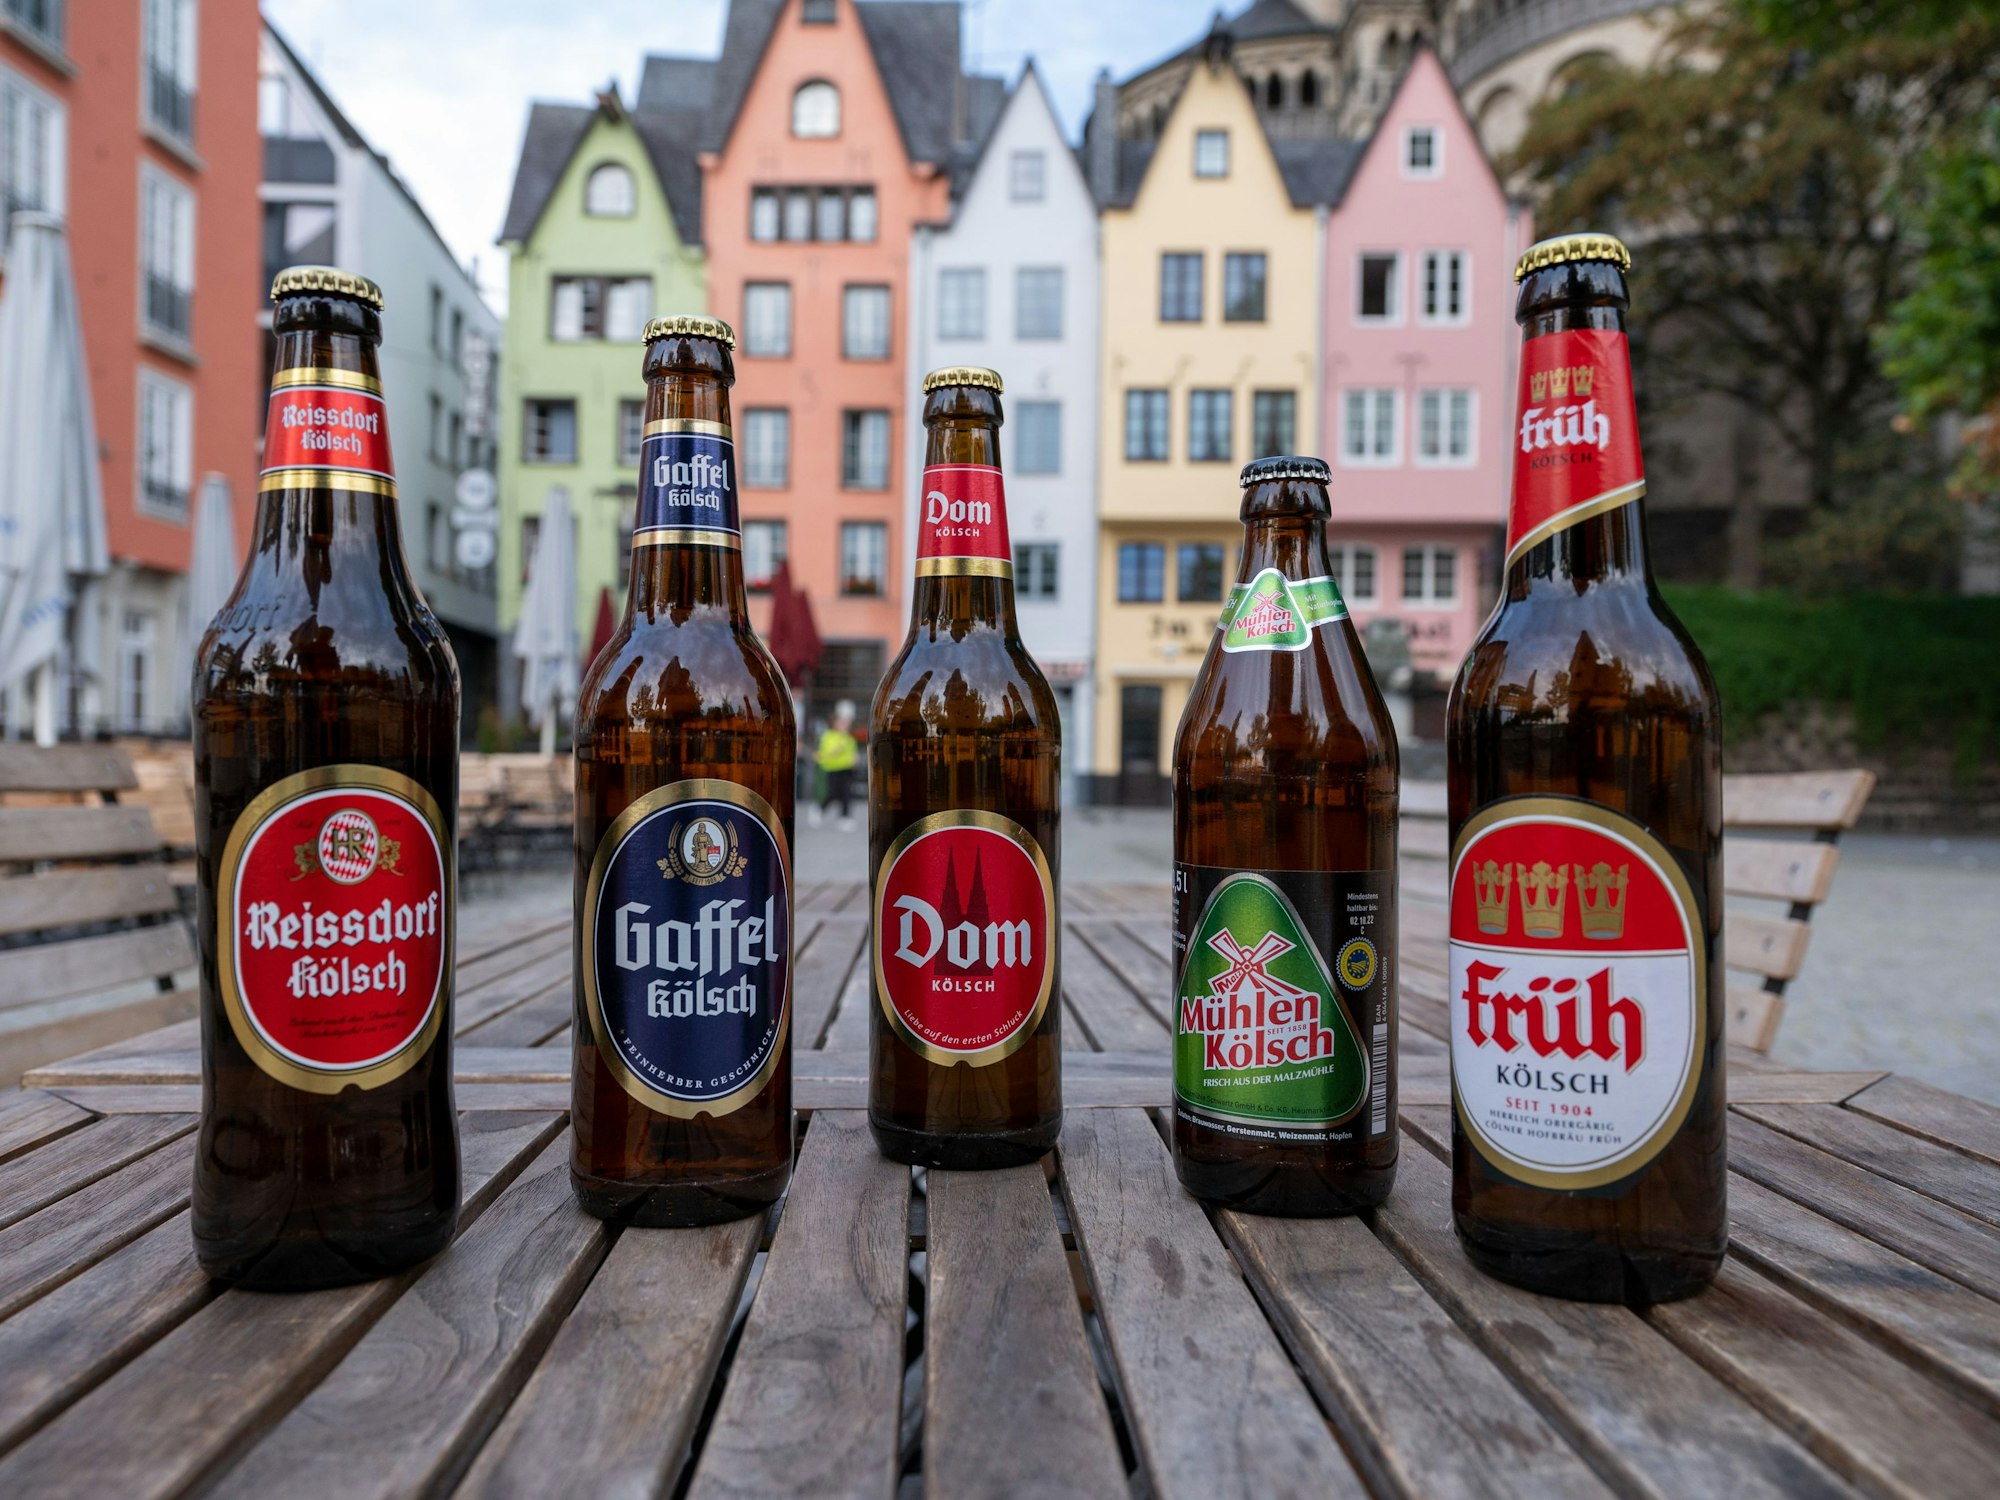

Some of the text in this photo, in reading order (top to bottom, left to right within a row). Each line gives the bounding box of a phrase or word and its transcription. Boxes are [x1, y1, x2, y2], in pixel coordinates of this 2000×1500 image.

[282, 402, 378, 435] Reissdorf
[301, 428, 362, 457] Kölsch
[653, 453, 731, 492] Gaffel
[1531, 452, 1592, 470] KÖLSCH
[926, 490, 992, 526] Dom
[935, 526, 980, 537] KÖLSCH
[1234, 609, 1292, 632] Mühlen
[1246, 620, 1297, 640] Kölsch
[1347, 892, 1379, 900] Mindestens
[244, 890, 439, 951] Reissdorf
[893, 894, 1032, 970] Dom
[615, 895, 779, 977] Gaffel
[286, 950, 407, 999] Kölsch
[931, 977, 995, 993] KÖLSCH
[1216, 970, 1242, 996] Malz
[1181, 991, 1319, 1032] Mühlen
[904, 1009, 1023, 1045] Liebe auf den ersten Schluck
[1267, 1024, 1307, 1035] SEIT 1858
[1206, 1021, 1333, 1068] Kölsch
[623, 1028, 773, 1089] FEINHERBER GESCHMACK
[1203, 1063, 1335, 1087] FRISCH AUS DER MALZMÜHLE
[1497, 1062, 1609, 1094] KÖLSCH
[1505, 1096, 1593, 1116] SEIT 1904
[1191, 1115, 1226, 1132] Brauwasser,
[1226, 1124, 1277, 1140] Gerstenmalz,
[1278, 1131, 1328, 1141] Weizenmalz,
[1329, 1131, 1353, 1141] Hopfen
[1485, 1120, 1622, 1144] CÖLNER HOFBRÄU FRÜH
[1489, 1109, 1615, 1131] HERRLICH OBERGÄRIG
